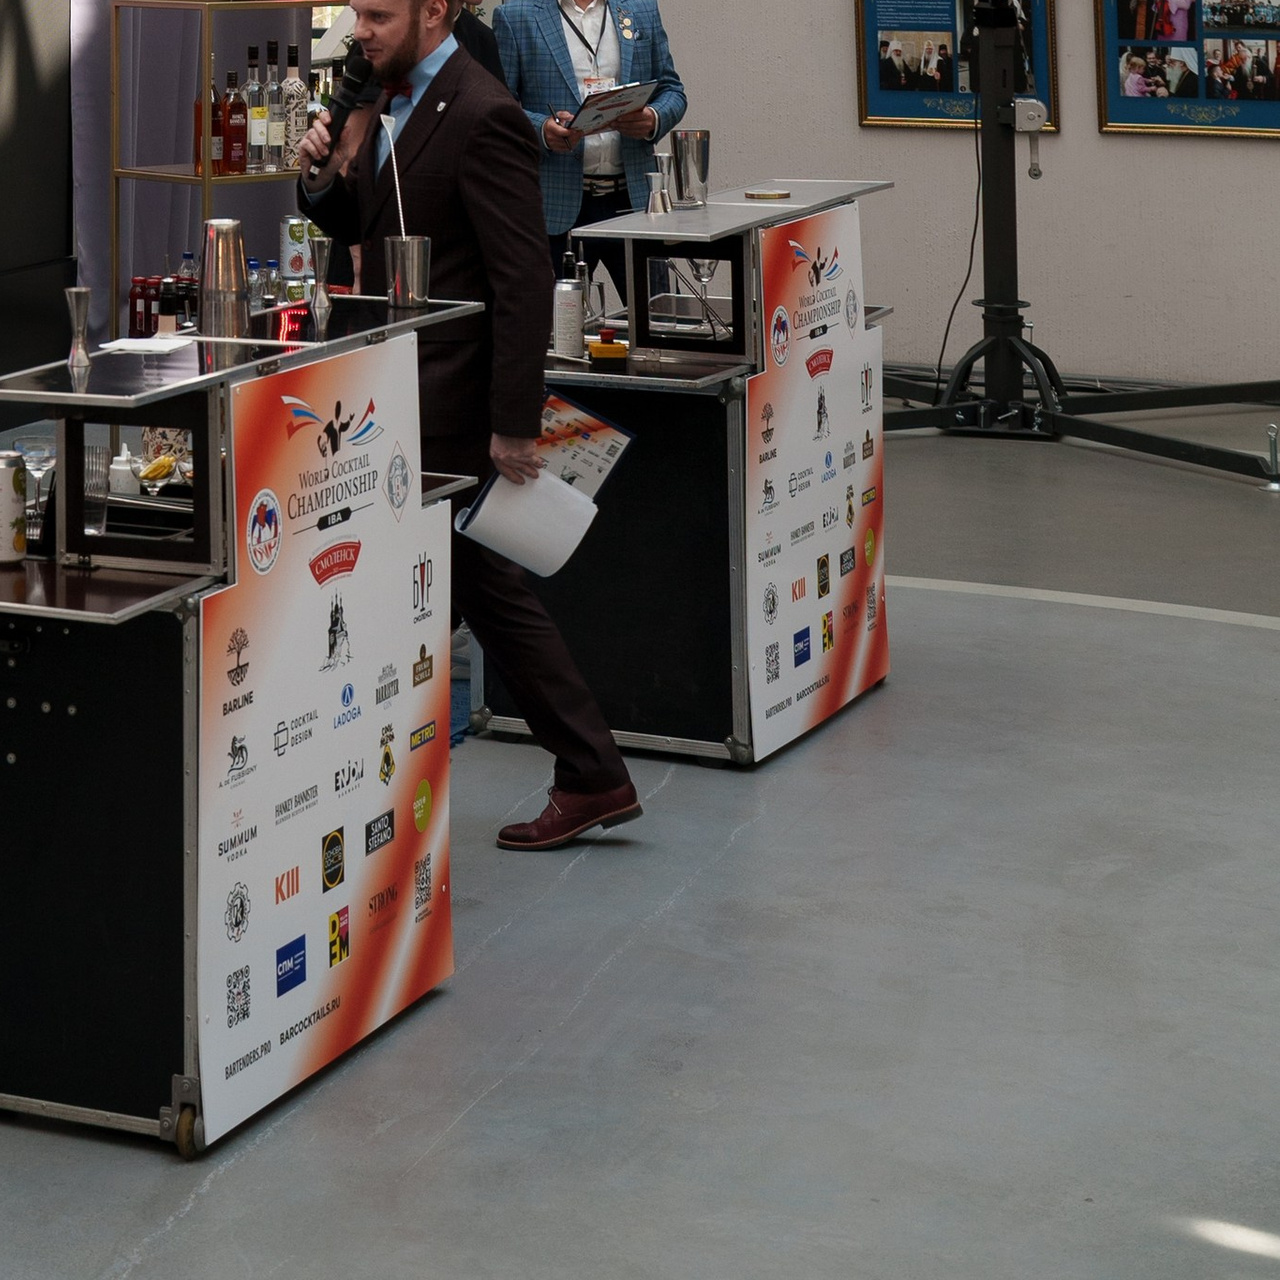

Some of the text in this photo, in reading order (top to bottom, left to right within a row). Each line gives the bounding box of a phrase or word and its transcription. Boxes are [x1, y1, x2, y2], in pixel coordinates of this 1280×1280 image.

[793, 299, 841, 330] CHAMPIONSHIP
[331, 453, 371, 479] COCKTAIL
[287, 470, 378, 520] CHAMPIONSHIP
[328, 512, 342, 525] IBA
[315, 548, 355, 575] СМОЛЕНСК
[222, 690, 254, 717] BARLINE
[376, 678, 400, 706] BARRISTER
[290, 709, 319, 731] COCKTAIL
[333, 706, 362, 730] LADOGA
[290, 728, 313, 747] DESIGN
[411, 724, 435, 747] METRO
[368, 826, 392, 851] STEFANO
[371, 815, 389, 836] SANTO
[218, 825, 257, 857] SUMMUM
[227, 847, 248, 863] VODKA
[368, 885, 398, 917] STRONG
[277, 957, 294, 976] СПМ
[279, 995, 341, 1046] BARCOCKTAILS.RU
[225, 1040, 272, 1081] BARTENDERS.PRO
